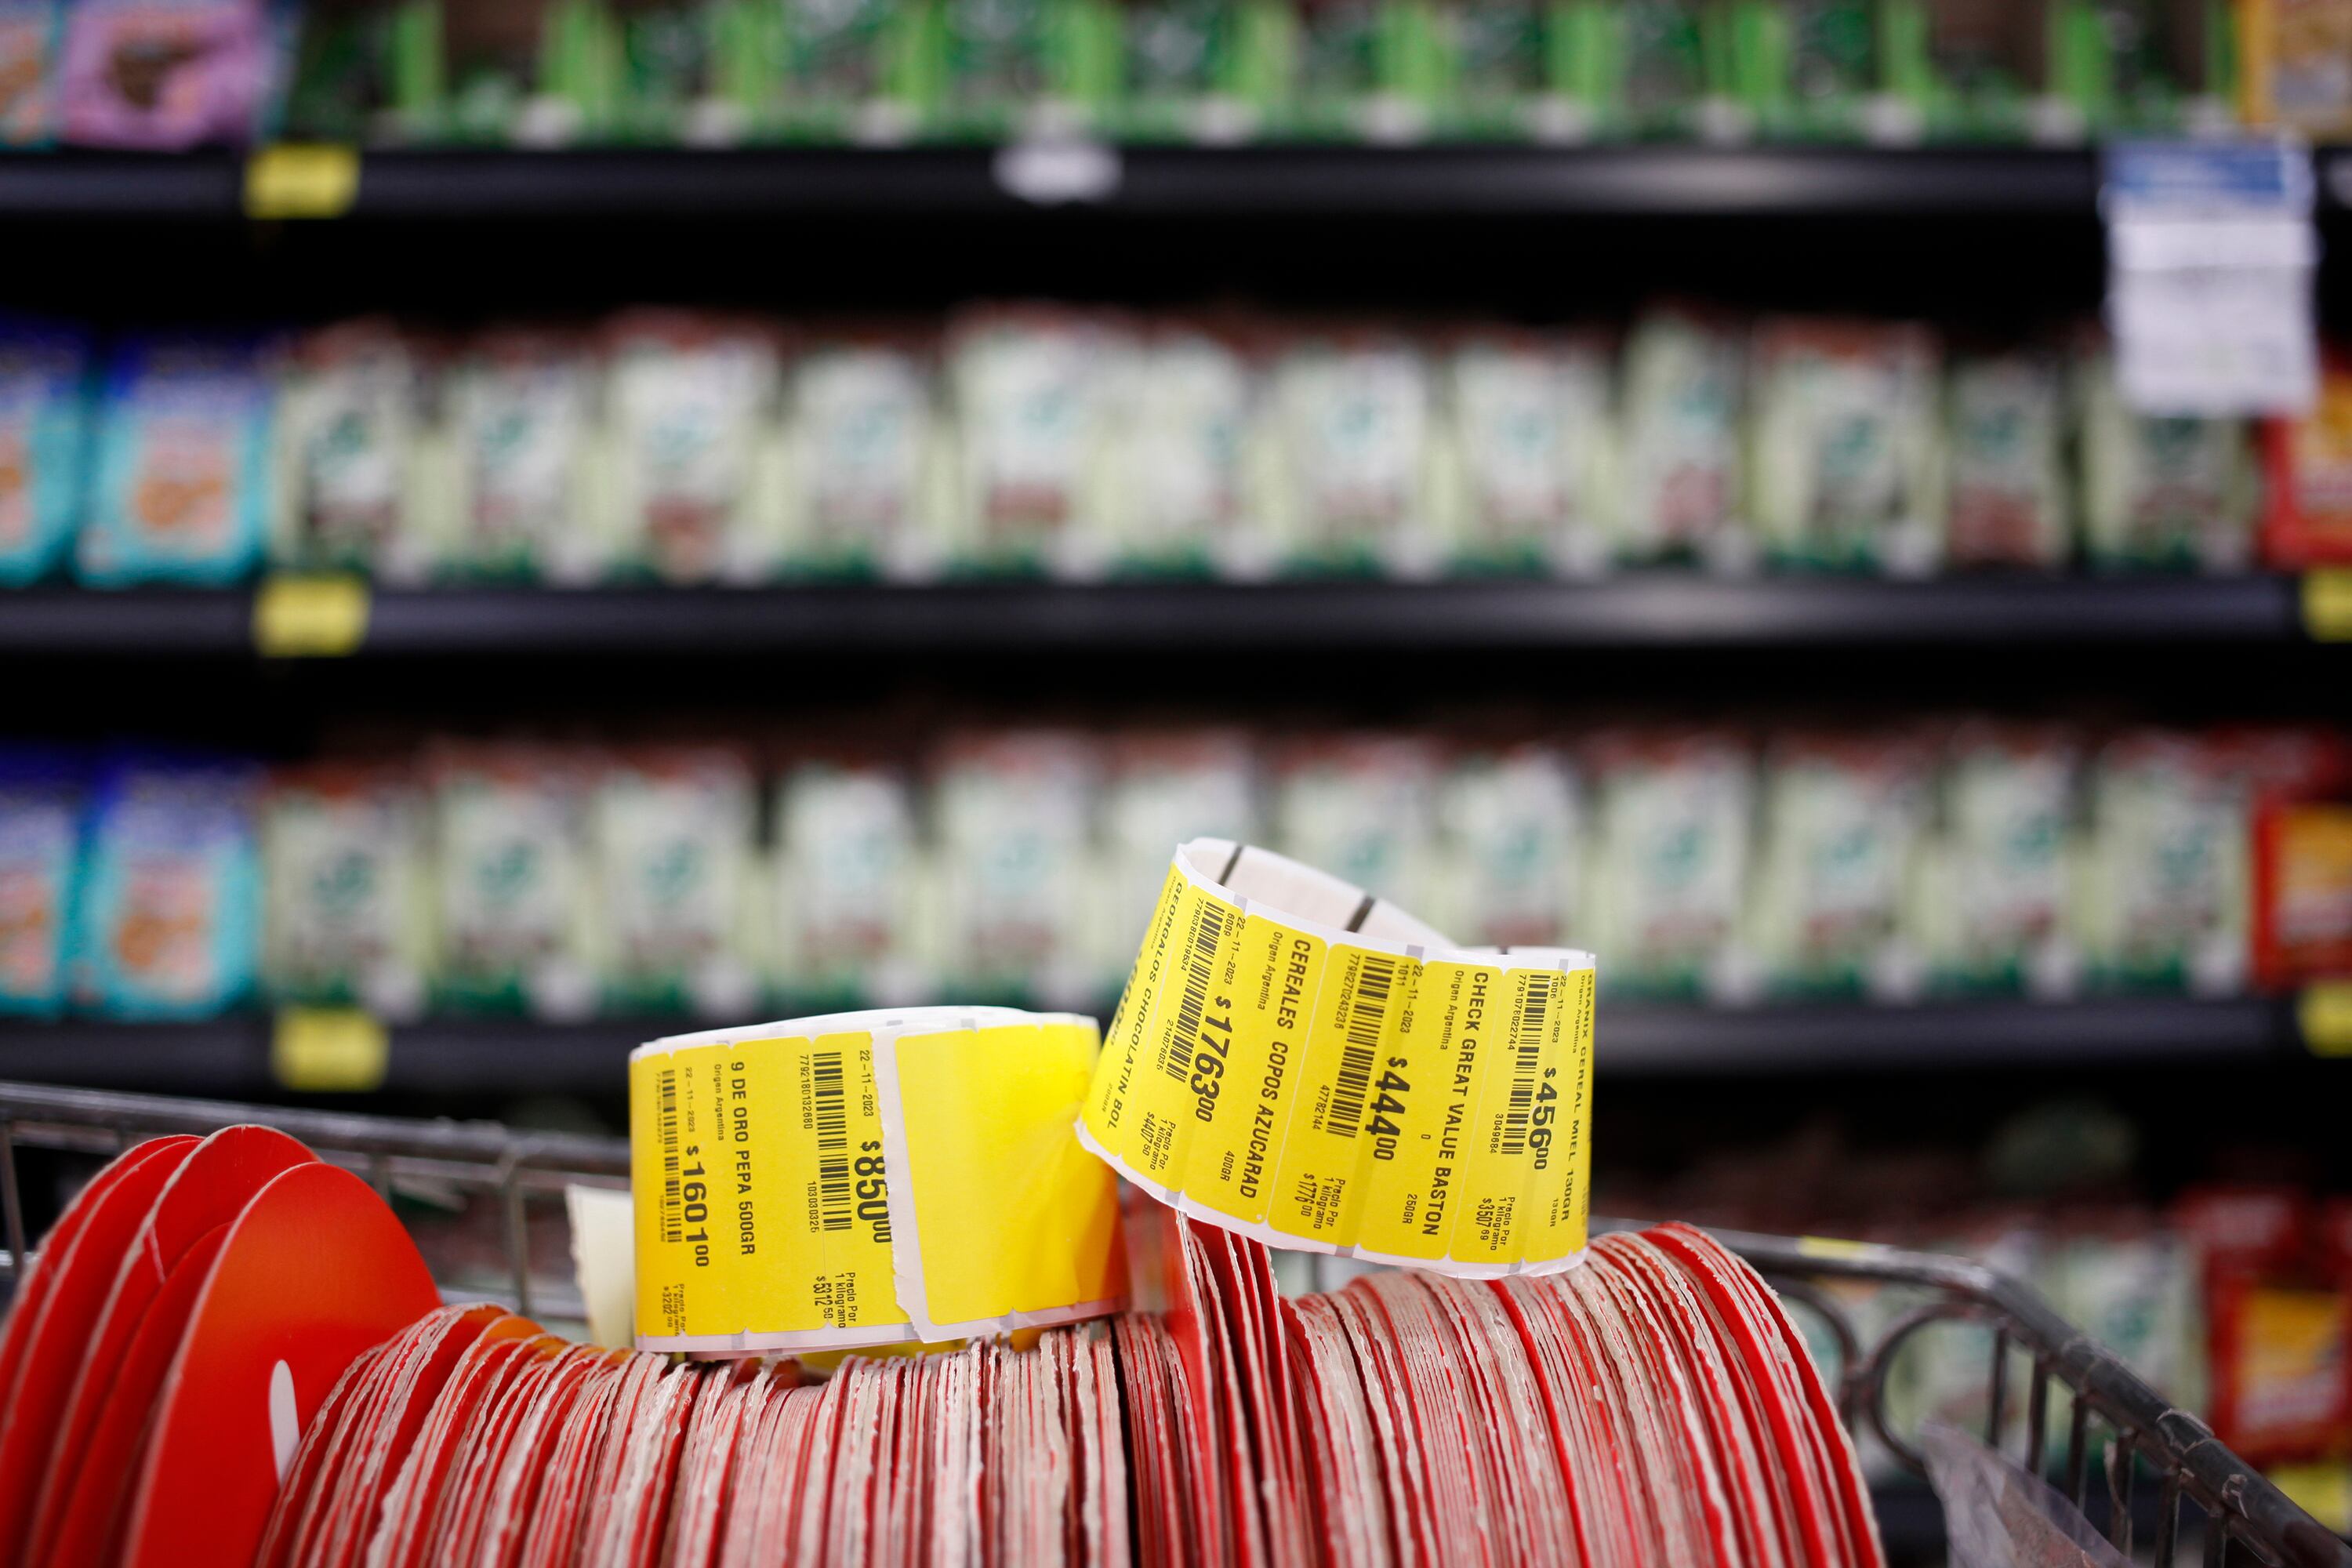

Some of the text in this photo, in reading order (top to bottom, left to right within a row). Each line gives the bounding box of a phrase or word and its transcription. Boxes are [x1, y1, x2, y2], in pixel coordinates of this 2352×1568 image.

[1149, 882, 1182, 982] GEORGALOS
[1224, 913, 1235, 936] 6009
[1258, 931, 1283, 1010] Origen Argentina
[1396, 964, 1409, 986] 1011
[1440, 971, 1465, 1050] Origen Argentina
[1118, 988, 1152, 1094] CHOCOLATIN
[800, 1054, 813, 1129] 7792180132680
[1240, 940, 1311, 1198] CEREALES COPOS AZUCARAD
[715, 1097, 724, 1141] Argentina
[1107, 1098, 1123, 1129] BOL
[1312, 1084, 1330, 1130] 47782144
[1422, 972, 1488, 1235] CHECK GREAT VALUE BASTON
[1562, 974, 1592, 1221] GRANIX CEREAL MIEL 130GR
[731, 1062, 755, 1254] 9 DE ORO PEPA 500GR
[1150, 1126, 1165, 1170] kilogramo
[1159, 1121, 1175, 1169] Precio Por
[1220, 1151, 1235, 1181] 400GR
[1314, 1185, 1333, 1229] kilogramo
[1326, 1178, 1346, 1227] Precio Por
[1403, 1194, 1417, 1224] 250GR
[1500, 1197, 1515, 1245] Precio Por
[1490, 1207, 1505, 1250] kilogramo
[835, 1283, 846, 1328] kilogramo
[846, 1272, 858, 1322] Precio Por
